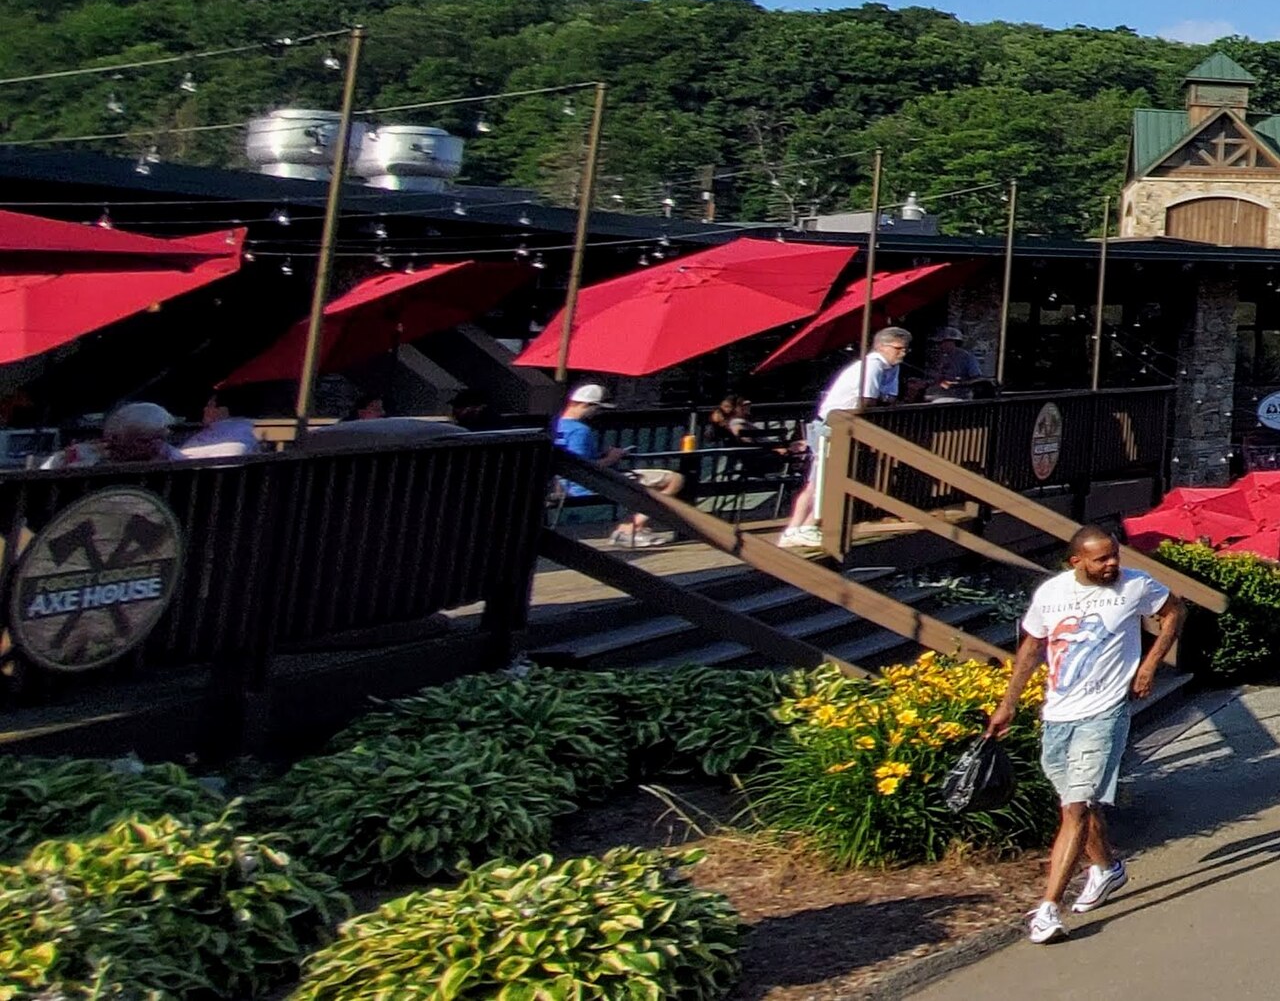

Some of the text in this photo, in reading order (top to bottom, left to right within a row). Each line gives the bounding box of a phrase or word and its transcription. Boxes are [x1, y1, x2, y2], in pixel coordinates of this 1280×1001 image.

[27, 590, 80, 617] AXE
[82, 578, 162, 607] HOUSE
[1086, 597, 1126, 609] STONES
